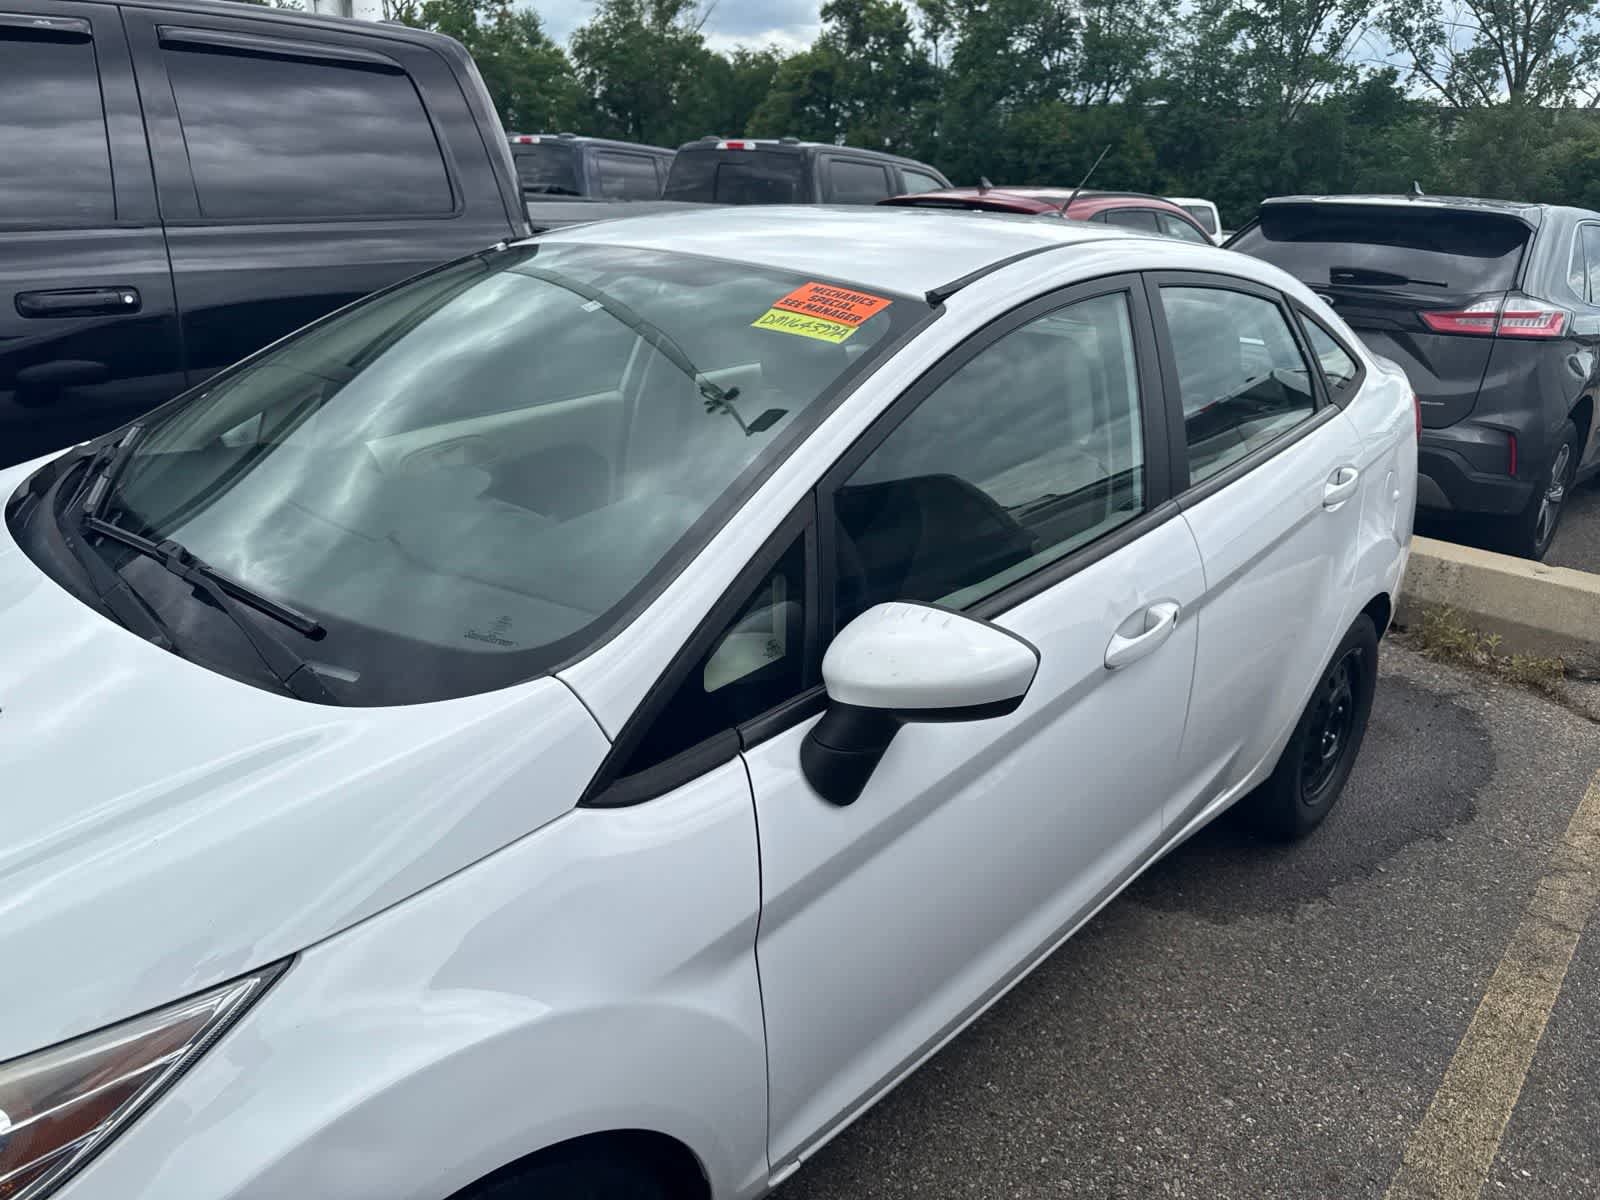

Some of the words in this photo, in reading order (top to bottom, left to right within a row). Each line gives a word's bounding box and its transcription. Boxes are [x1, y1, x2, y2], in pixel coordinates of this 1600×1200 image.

[807, 294, 856, 311] SPECIAL
[809, 286, 877, 306] MECHANICS
[781, 298, 805, 308] SEE
[802, 303, 863, 323] MANAGER
